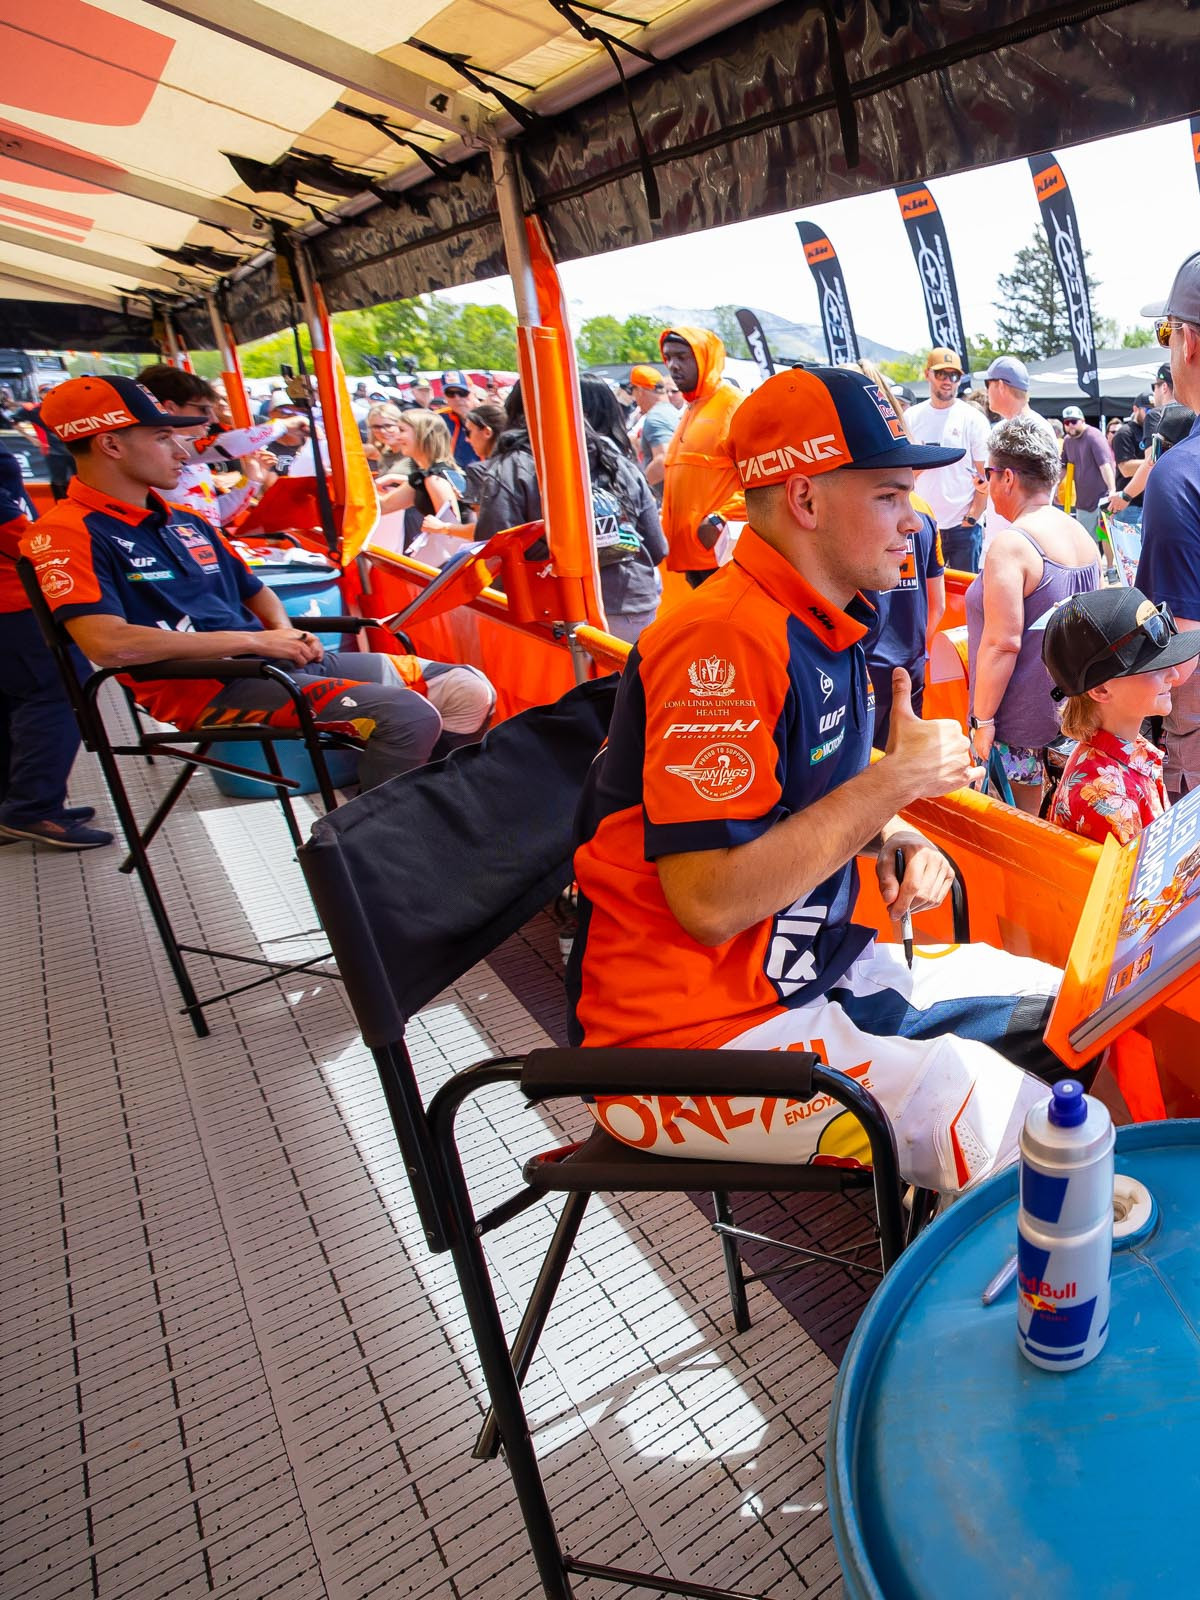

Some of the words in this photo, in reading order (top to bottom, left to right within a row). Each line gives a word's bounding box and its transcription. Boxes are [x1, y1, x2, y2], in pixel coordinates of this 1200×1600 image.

[430, 93, 449, 113] 4
[1037, 175, 1058, 193] KTM
[903, 198, 928, 212] KTM
[663, 719, 760, 739] pankl
[819, 705, 846, 734] WP
[699, 749, 716, 766] PROUD
[726, 747, 748, 765] SUPPORT
[710, 777, 735, 787] LIFE
[1169, 790, 1200, 857] JULIEN
[1132, 808, 1175, 909] BEAUMER
[1040, 1282, 1076, 1299] Bull
